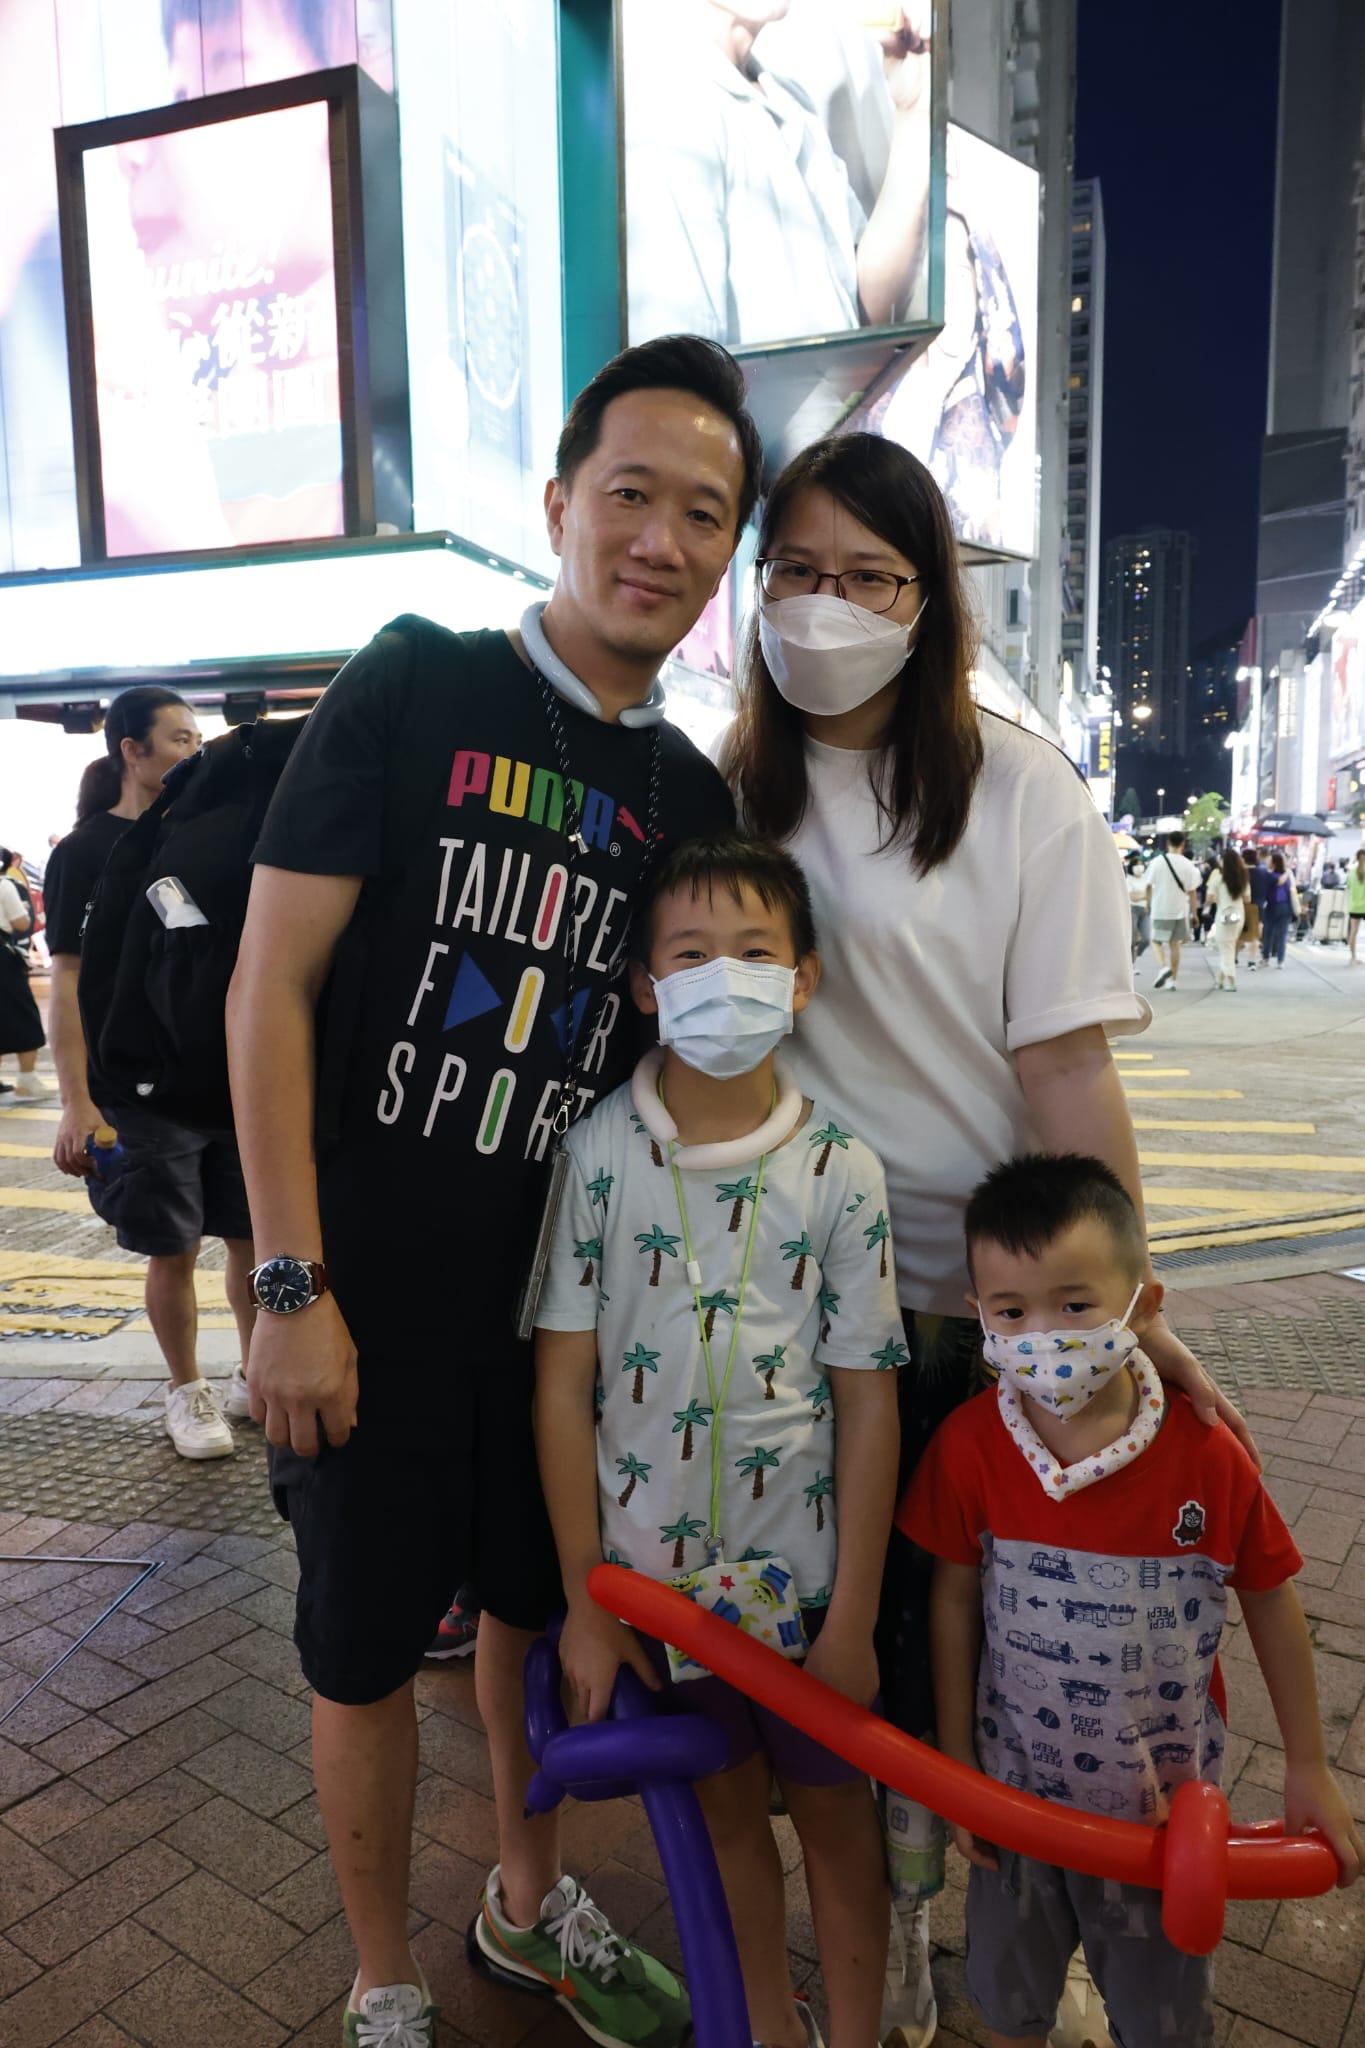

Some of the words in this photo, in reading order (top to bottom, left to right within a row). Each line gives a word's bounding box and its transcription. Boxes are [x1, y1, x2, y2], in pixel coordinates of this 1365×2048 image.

[447, 750, 614, 853] PUMA
[1071, 1713, 1101, 1728] PEEP!
[1073, 1724, 1104, 1738] PEEP!
